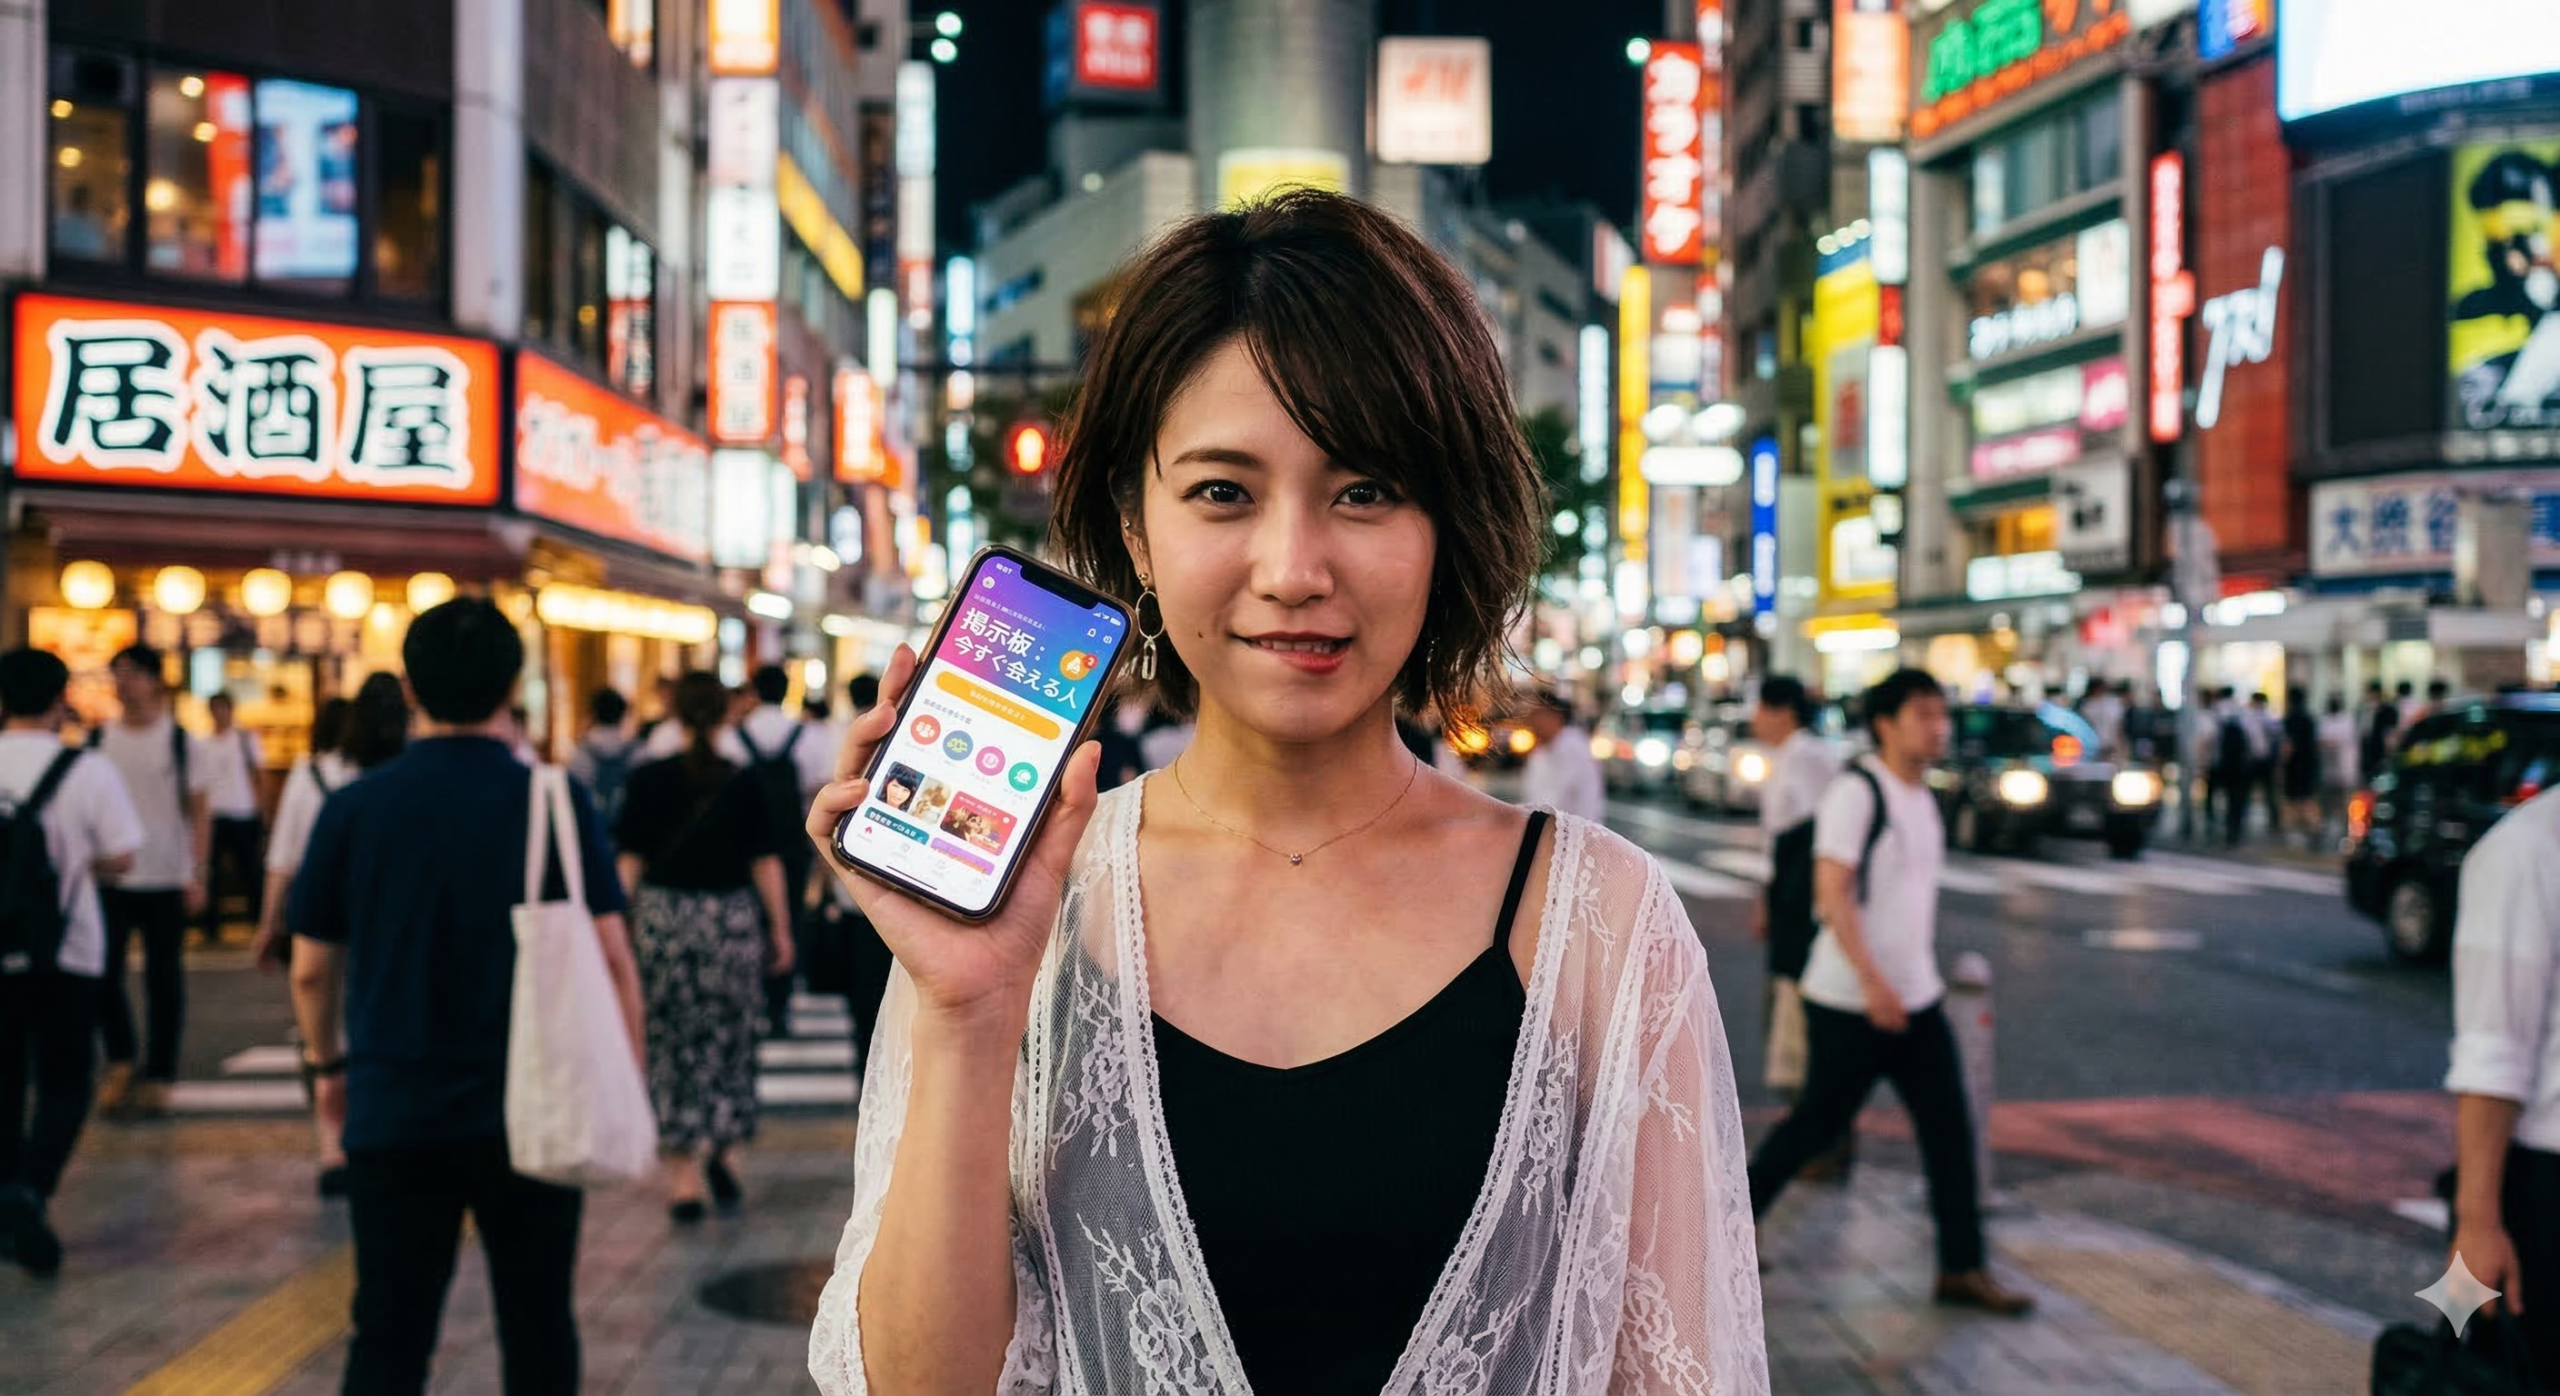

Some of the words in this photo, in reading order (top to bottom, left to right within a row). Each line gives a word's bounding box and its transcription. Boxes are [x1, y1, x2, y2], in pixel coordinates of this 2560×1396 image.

[48, 329, 462, 480] 居酒屋
[954, 635, 1077, 710] 今すぐ会える人
